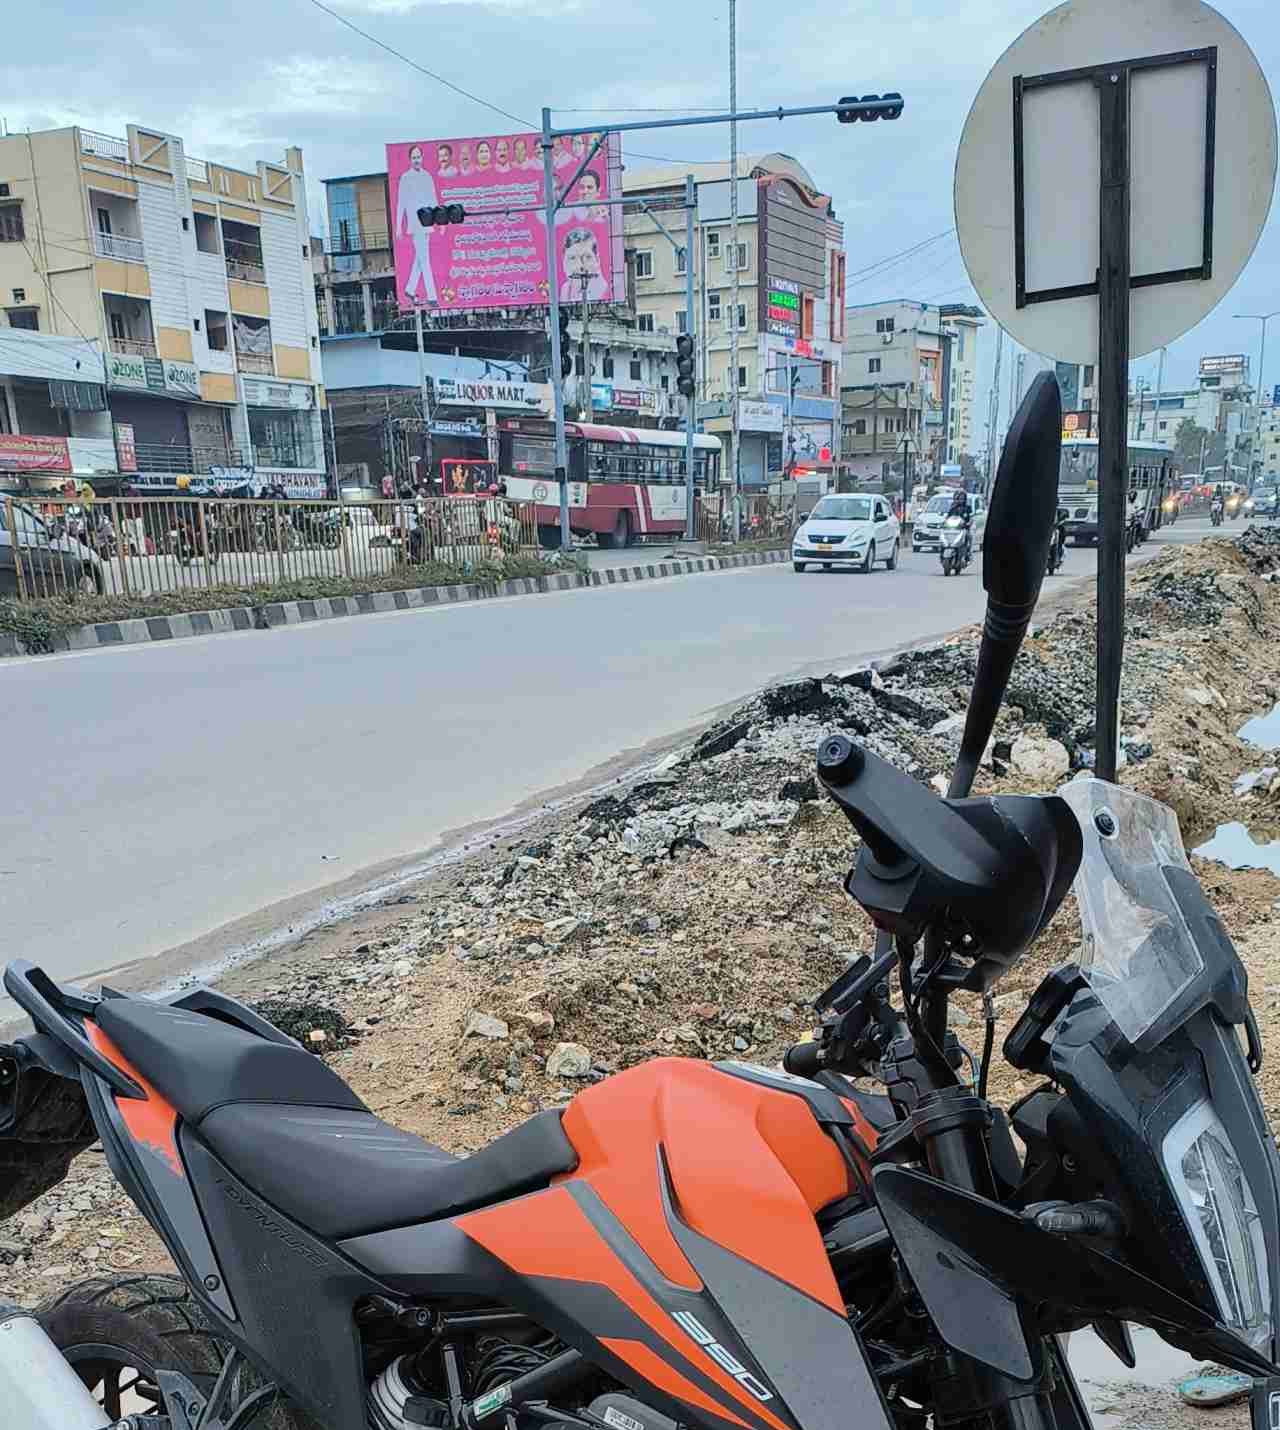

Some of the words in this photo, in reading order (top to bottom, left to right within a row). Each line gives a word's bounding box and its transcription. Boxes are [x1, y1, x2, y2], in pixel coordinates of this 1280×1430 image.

[457, 383, 494, 402] LIQUOR
[497, 385, 524, 401] MART
[670, 1311, 774, 1401] 390
